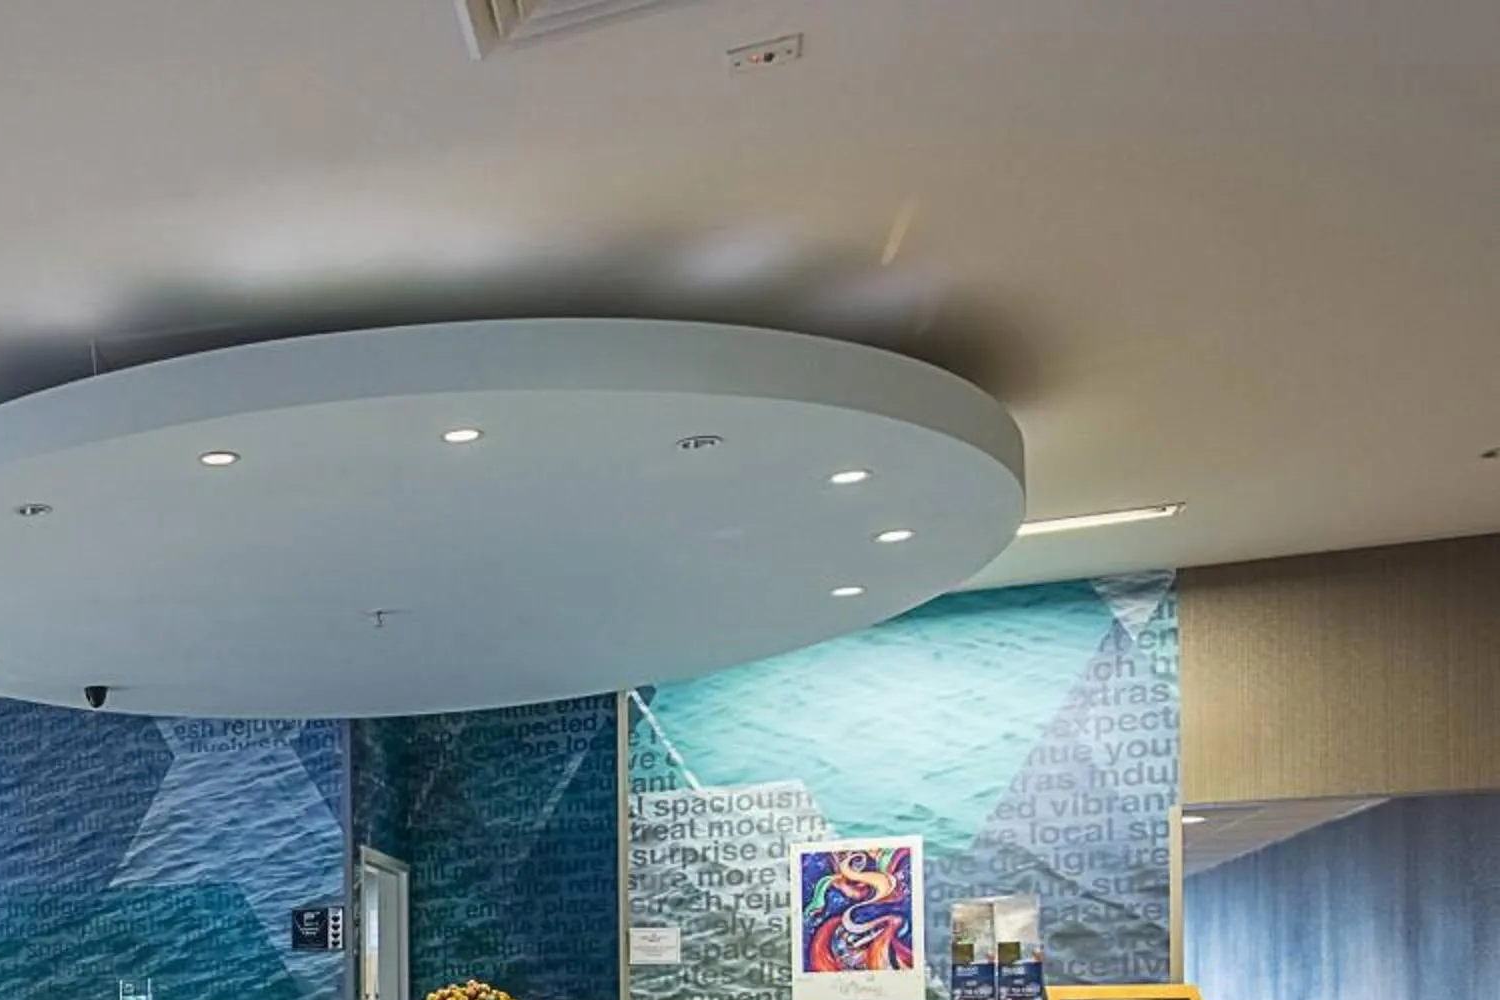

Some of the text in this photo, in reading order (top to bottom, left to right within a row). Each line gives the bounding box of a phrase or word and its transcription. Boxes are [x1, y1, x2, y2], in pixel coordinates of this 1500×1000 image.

[1053, 705, 1179, 741] expect
[632, 839, 757, 868] surprise
[696, 866, 778, 888] more
